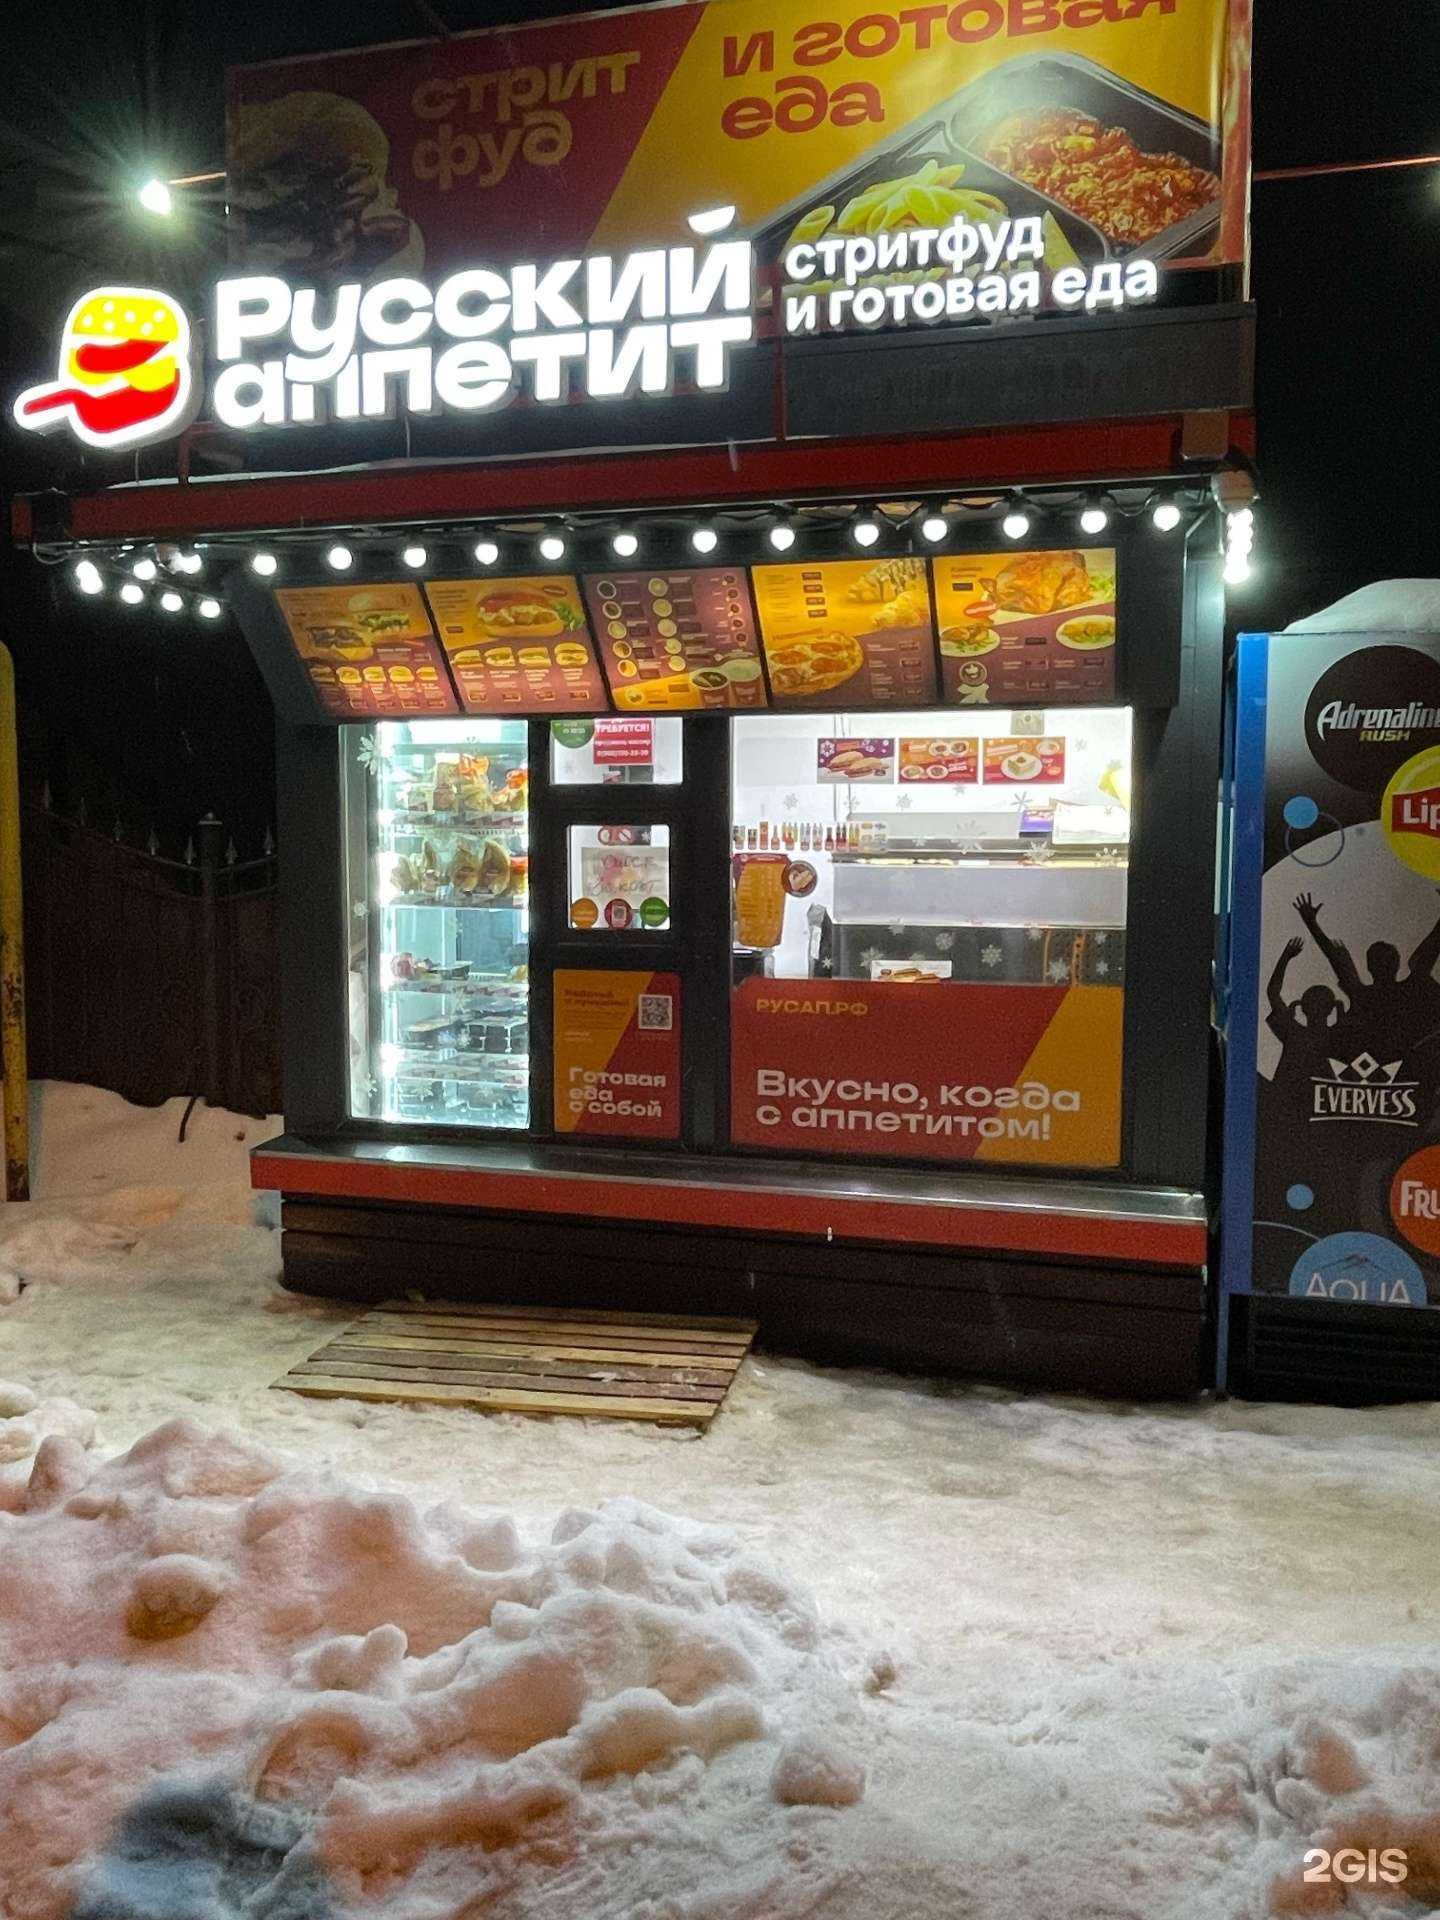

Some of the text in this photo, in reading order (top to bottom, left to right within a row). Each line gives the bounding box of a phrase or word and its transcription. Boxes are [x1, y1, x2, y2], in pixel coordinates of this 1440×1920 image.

[723, 29, 774, 78] и
[411, 51, 640, 121] стрит
[721, 75, 885, 141] еда
[413, 109, 573, 190] фуд
[785, 215, 1045, 286] стритфуд
[216, 206, 753, 383] Русский
[785, 259, 1159, 333] и готовая еда
[213, 316, 753, 429] аппетит
[1359, 729, 1412, 742] RUSH
[756, 998, 869, 1017] РУСАП.РФ
[569, 1066, 666, 1088] Готовая
[569, 1083, 613, 1101] еда
[756, 1068, 1082, 1113] Вкусно, когда
[1313, 1083, 1418, 1118] EVERVESS
[588, 1099, 662, 1118] собой
[756, 1105, 1051, 1141] с аппетитом!
